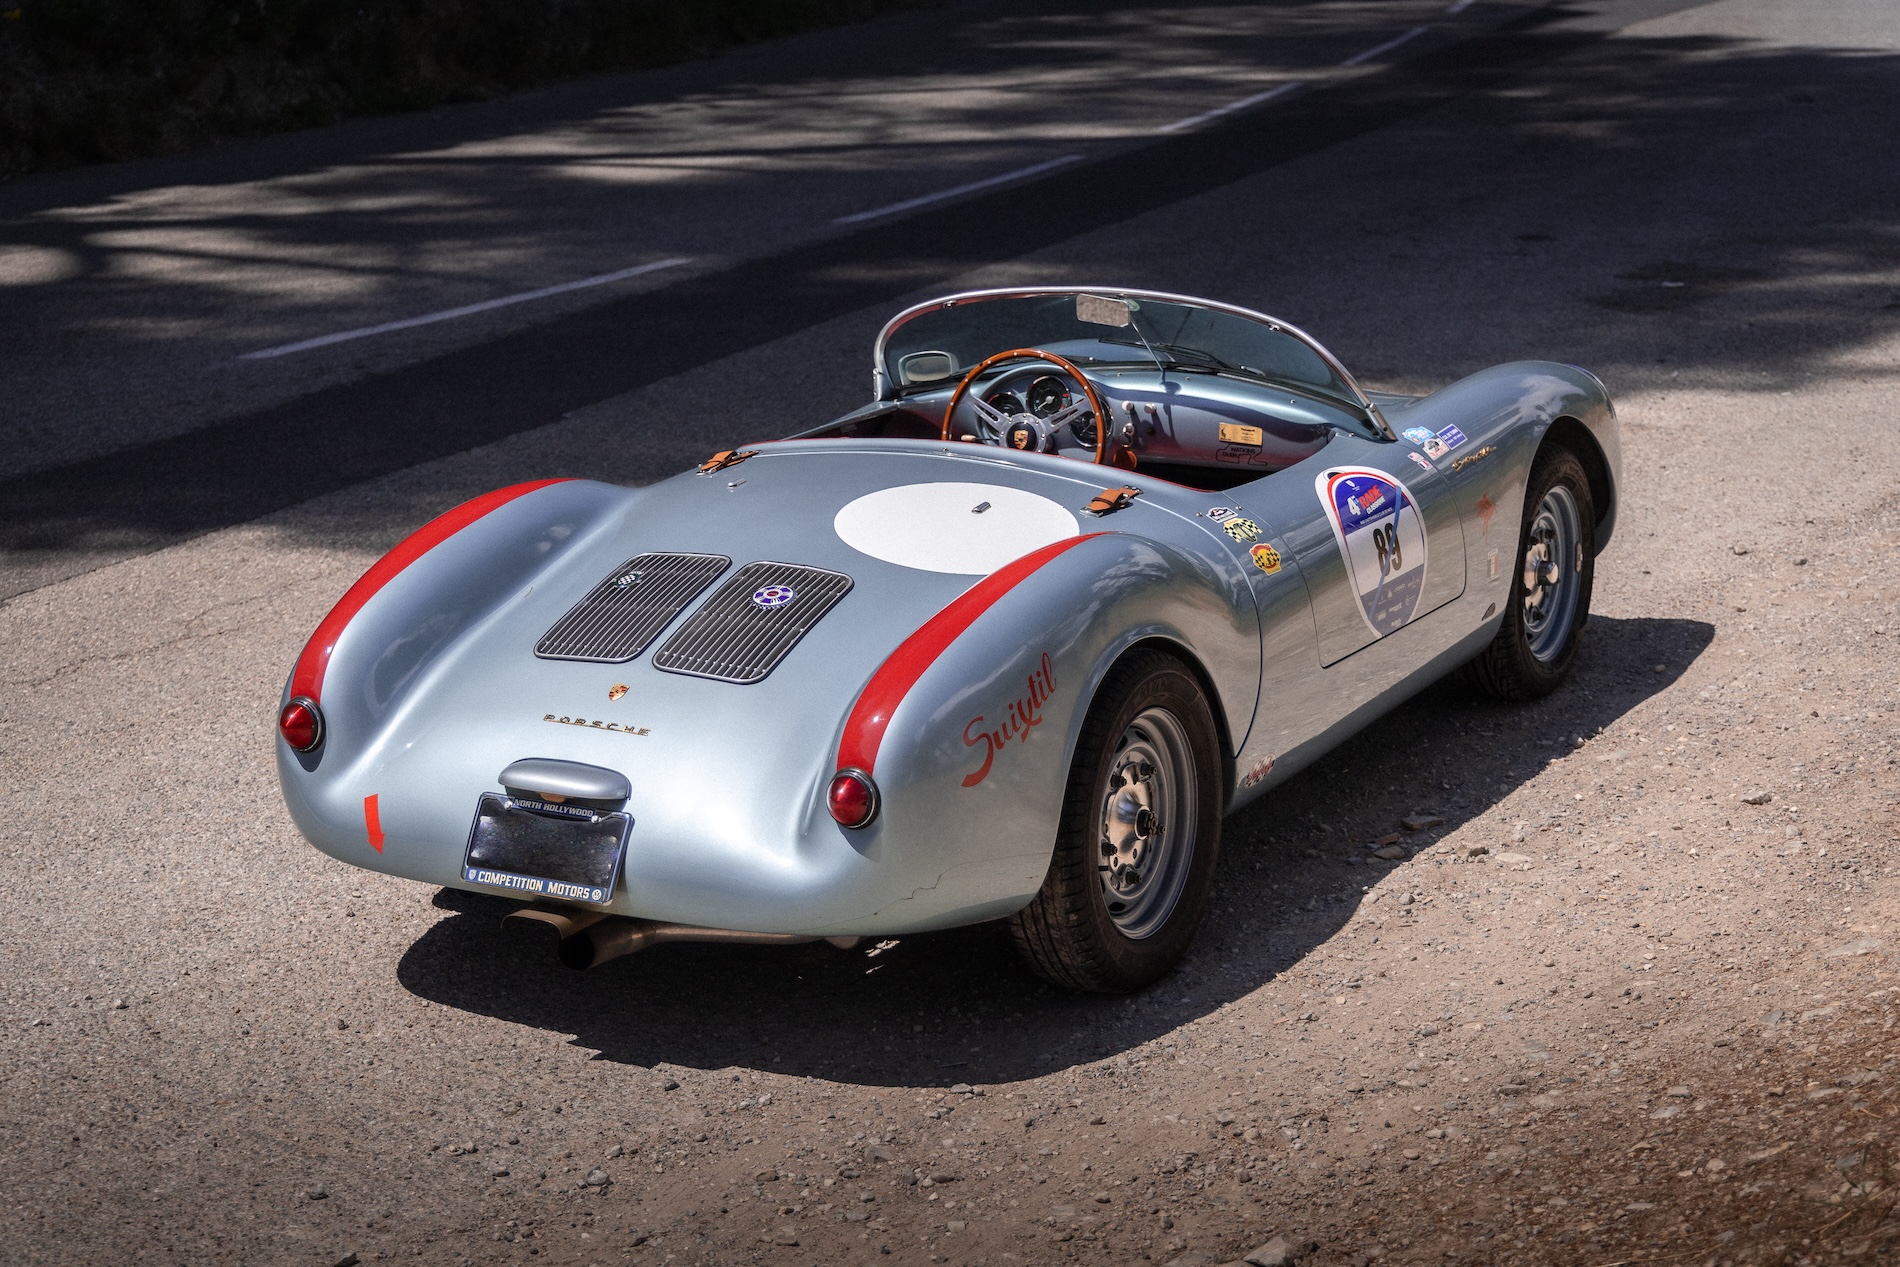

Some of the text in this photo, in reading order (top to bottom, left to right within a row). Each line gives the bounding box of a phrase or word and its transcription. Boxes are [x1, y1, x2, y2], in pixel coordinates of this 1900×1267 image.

[1372, 522, 1403, 577] 89
[543, 713, 652, 737] PORSCHE
[960, 651, 1057, 788] Suixtil
[513, 798, 594, 817] NORTH HOLLYWOOD
[477, 870, 543, 892] COMPETITION
[547, 881, 590, 900] MOTORS
